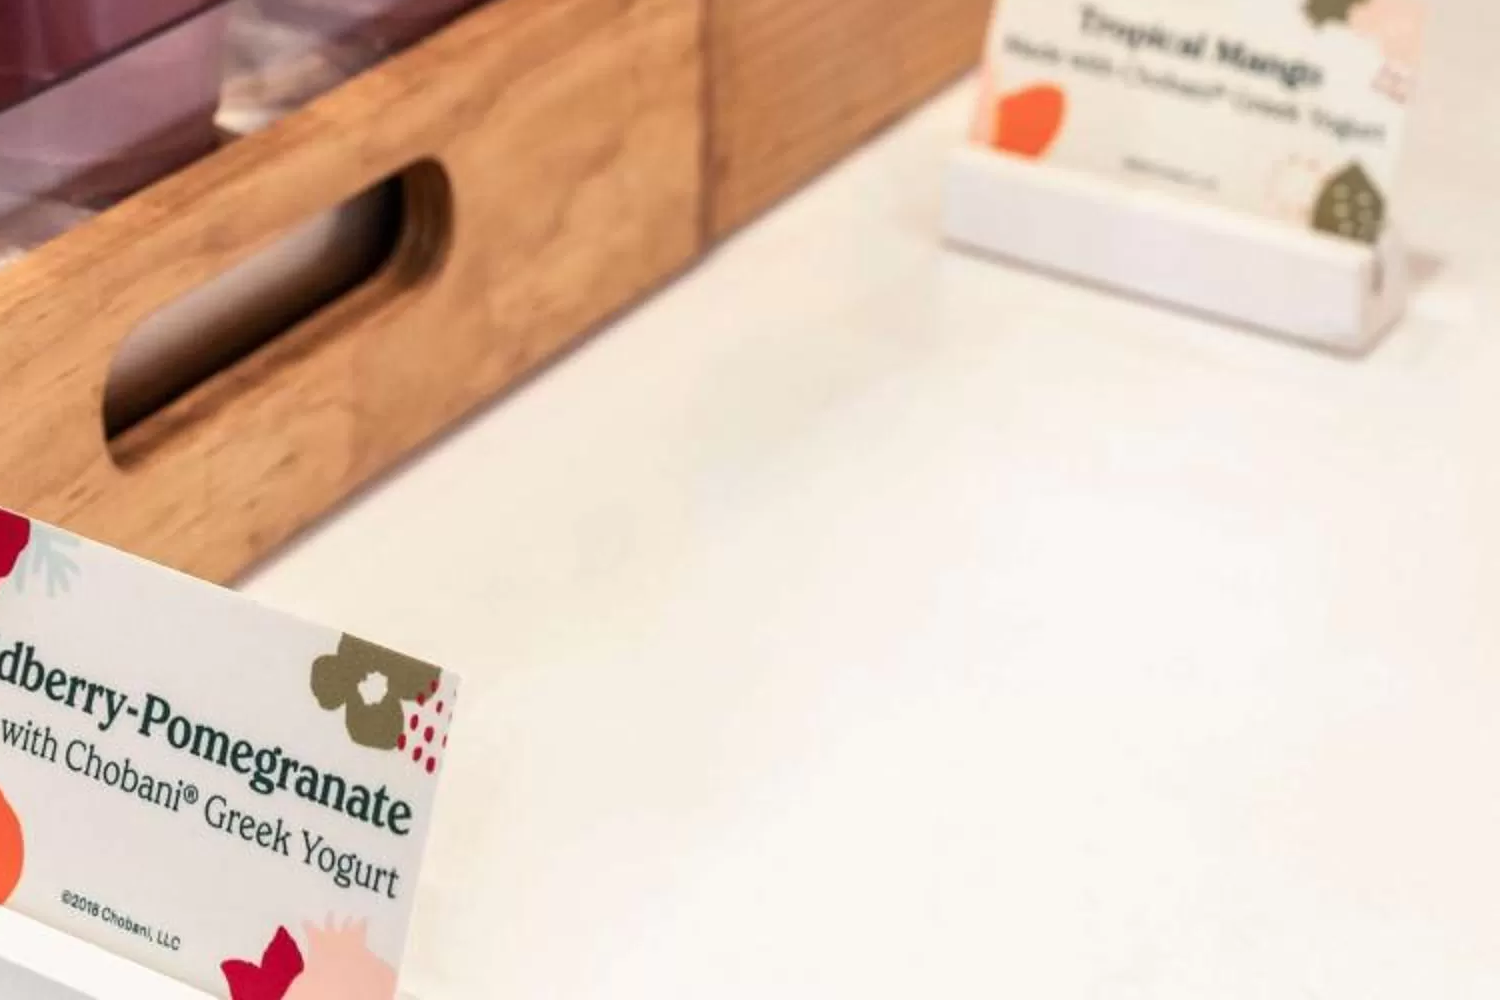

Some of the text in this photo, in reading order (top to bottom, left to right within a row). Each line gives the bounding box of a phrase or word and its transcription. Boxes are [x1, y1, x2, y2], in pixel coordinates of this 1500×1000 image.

[1, 718, 59, 763] with
[204, 794, 292, 857] Greek
[301, 828, 400, 899] Yogurt
[101, 906, 153, 943] Chobani,
[156, 929, 181, 951] LLC
